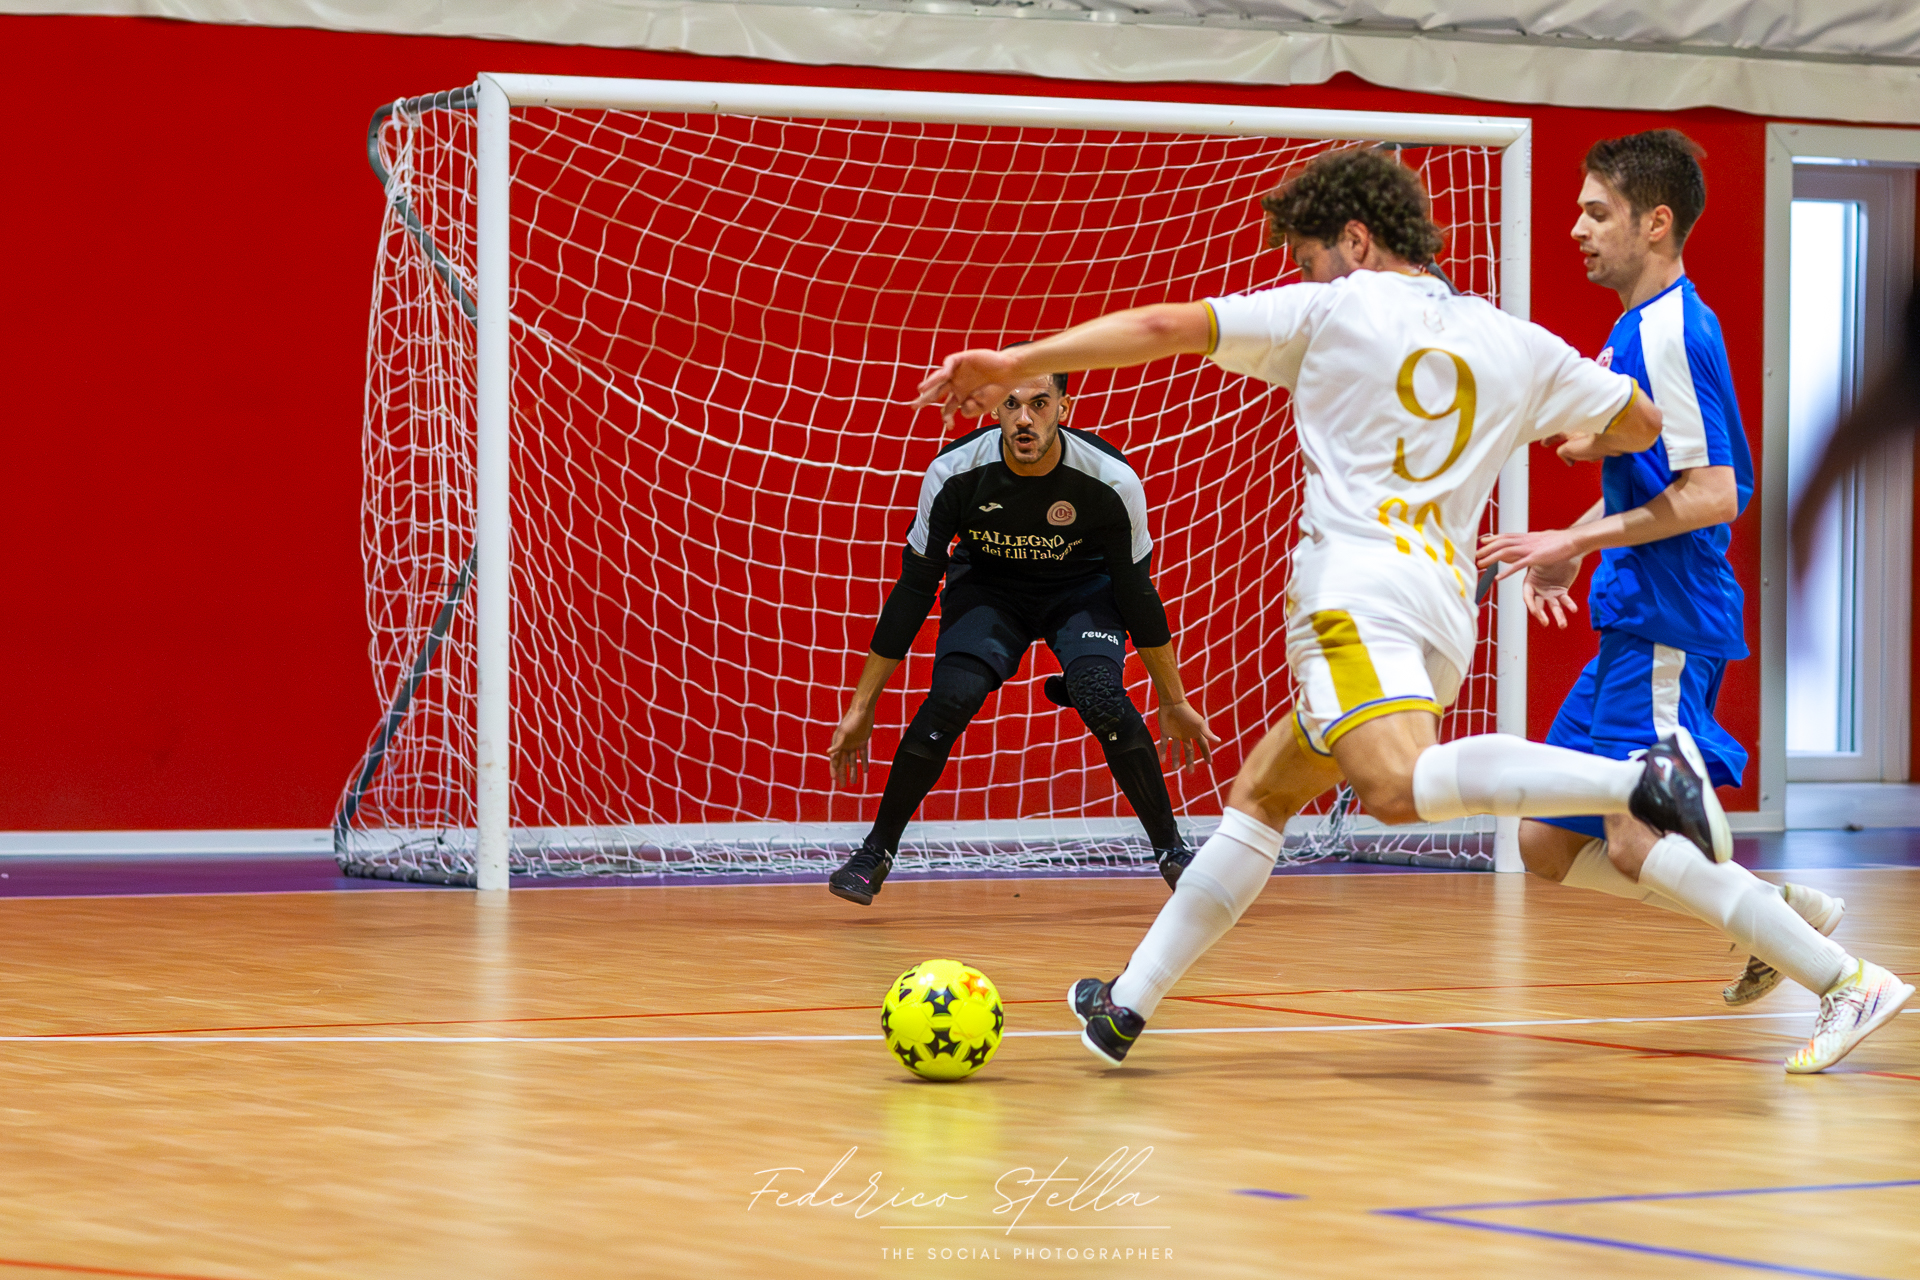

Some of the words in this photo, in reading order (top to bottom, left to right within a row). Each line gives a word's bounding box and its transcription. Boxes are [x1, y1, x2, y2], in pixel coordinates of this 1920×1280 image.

[1392, 347, 1477, 482] 9
[968, 529, 1065, 549] TALLEGNO
[982, 543, 1001, 556] dei
[1005, 548, 1027, 560] f.lli
[1081, 631, 1119, 645] reusch
